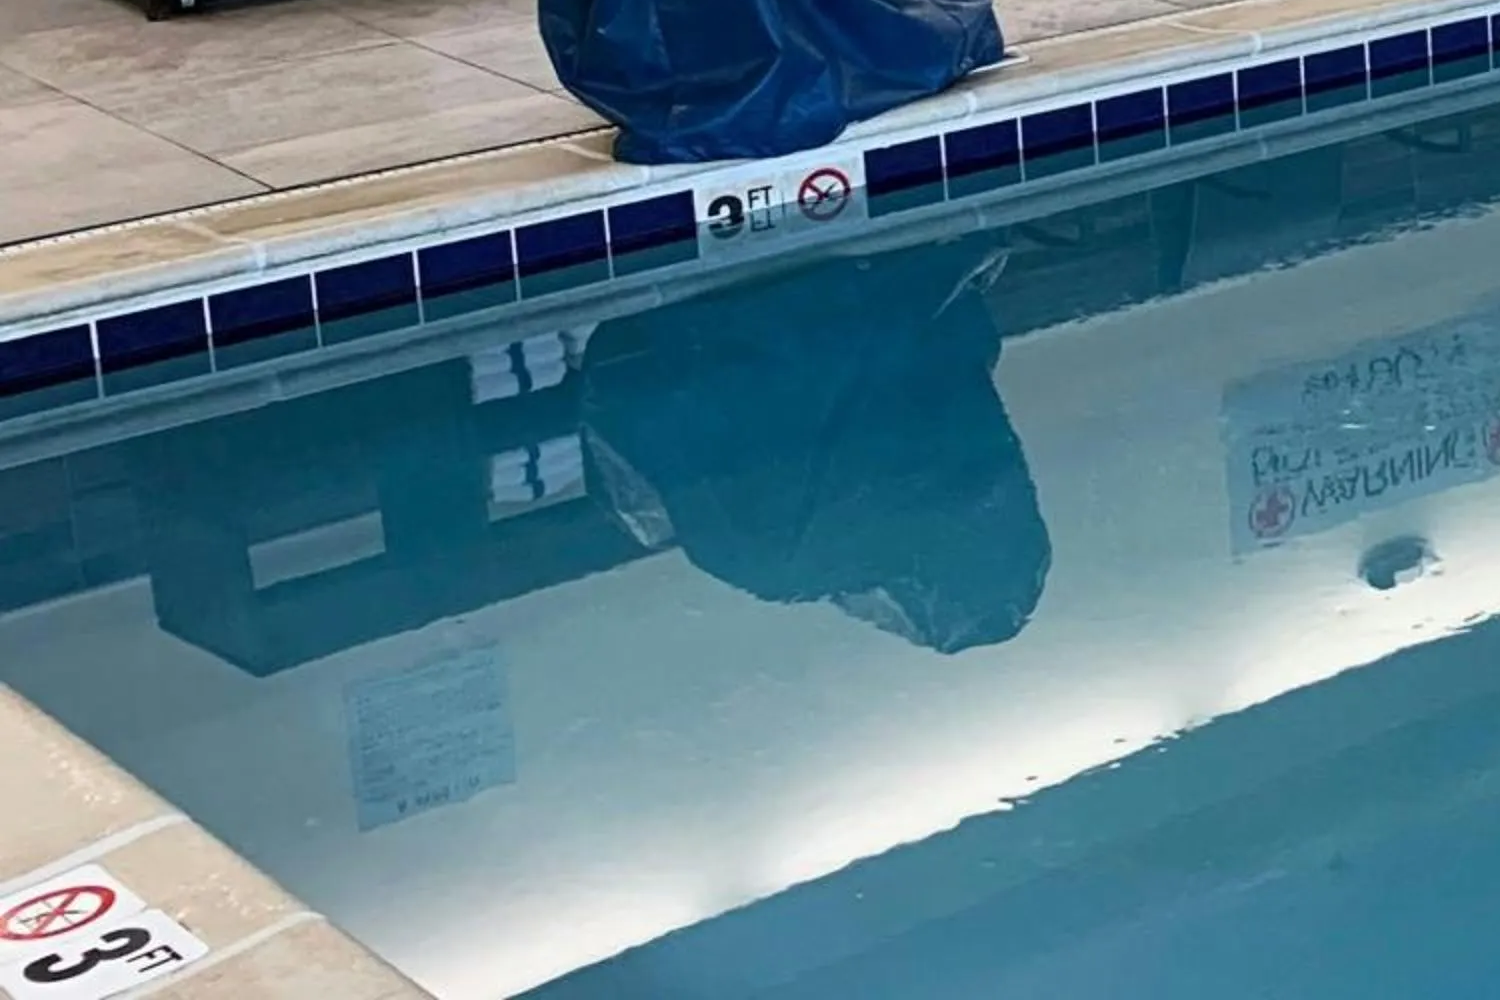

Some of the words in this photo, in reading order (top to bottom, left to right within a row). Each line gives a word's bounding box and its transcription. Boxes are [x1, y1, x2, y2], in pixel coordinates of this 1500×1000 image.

[708, 195, 745, 235] 3
[22, 927, 151, 983] 3
[125, 944, 184, 973] FT
